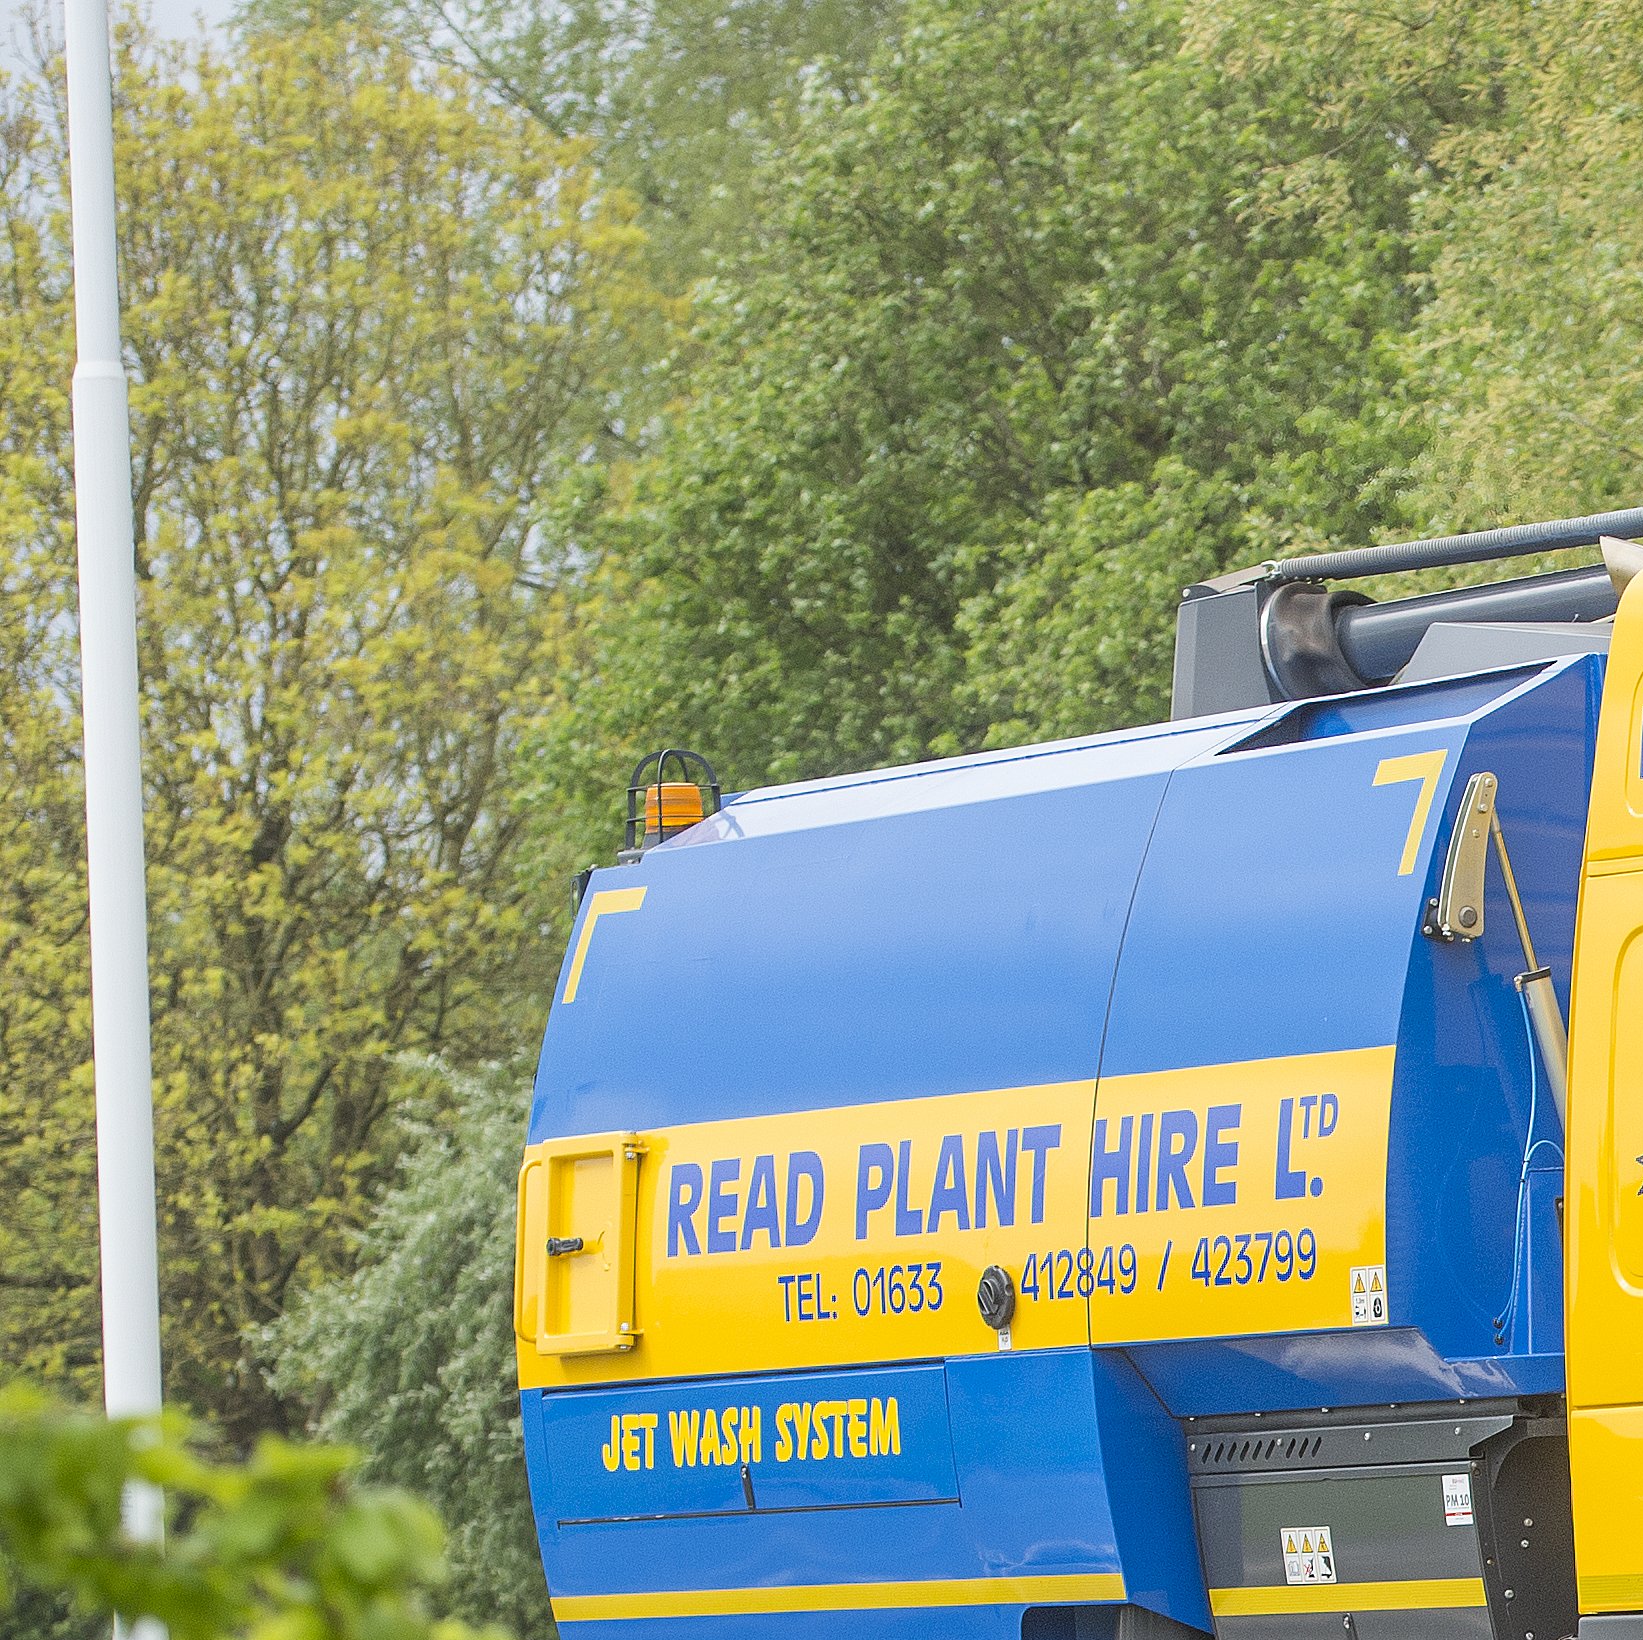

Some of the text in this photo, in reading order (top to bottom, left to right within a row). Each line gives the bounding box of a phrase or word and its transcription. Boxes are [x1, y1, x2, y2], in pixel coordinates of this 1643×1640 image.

[667, 1150, 824, 1259] READ
[855, 1123, 1062, 1241] PLANT
[1089, 1104, 1243, 1219] HIRE
[778, 1274, 839, 1322] TEL:
[853, 1261, 944, 1316] 01633
[1020, 1244, 1138, 1304] 412849
[1191, 1228, 1317, 1289] 423799
[602, 1396, 901, 1472] JET WASH SYSTEM
[1446, 1494, 1470, 1507] PM 10
